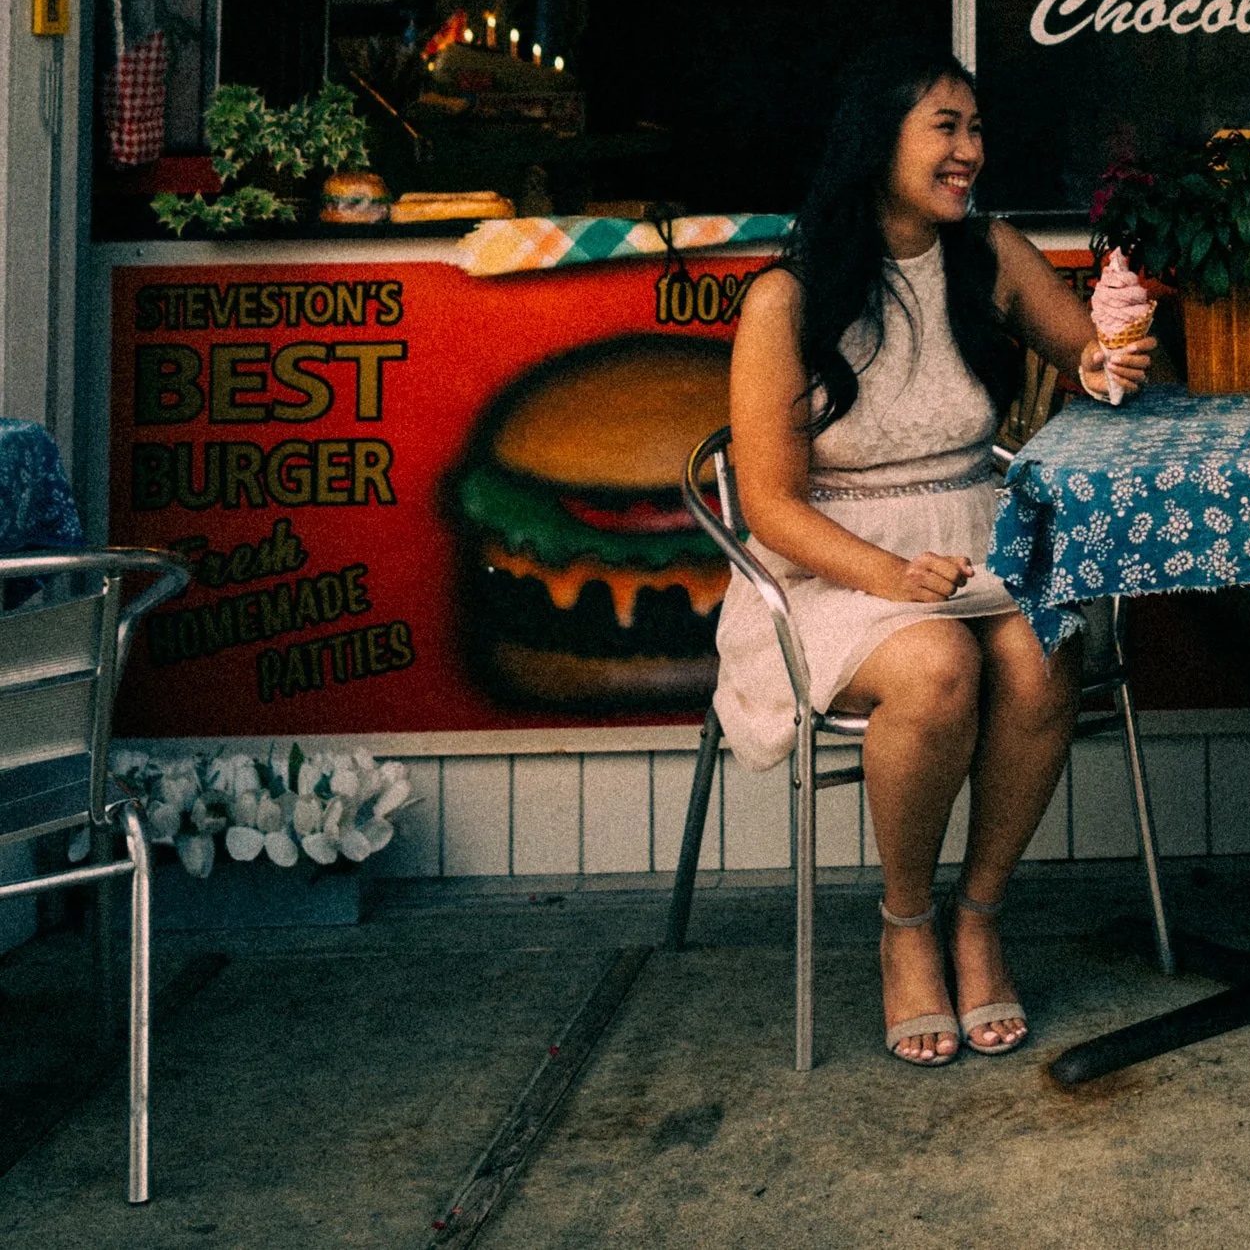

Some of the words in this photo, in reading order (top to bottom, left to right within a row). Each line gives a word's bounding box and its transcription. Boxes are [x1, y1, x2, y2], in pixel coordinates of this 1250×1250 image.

[135, 281, 403, 331] STEVESTON'S
[134, 341, 406, 426] BEST
[131, 440, 396, 511] BURGER
[148, 563, 372, 667] HOMEMADE
[257, 620, 415, 703] PATTIES
